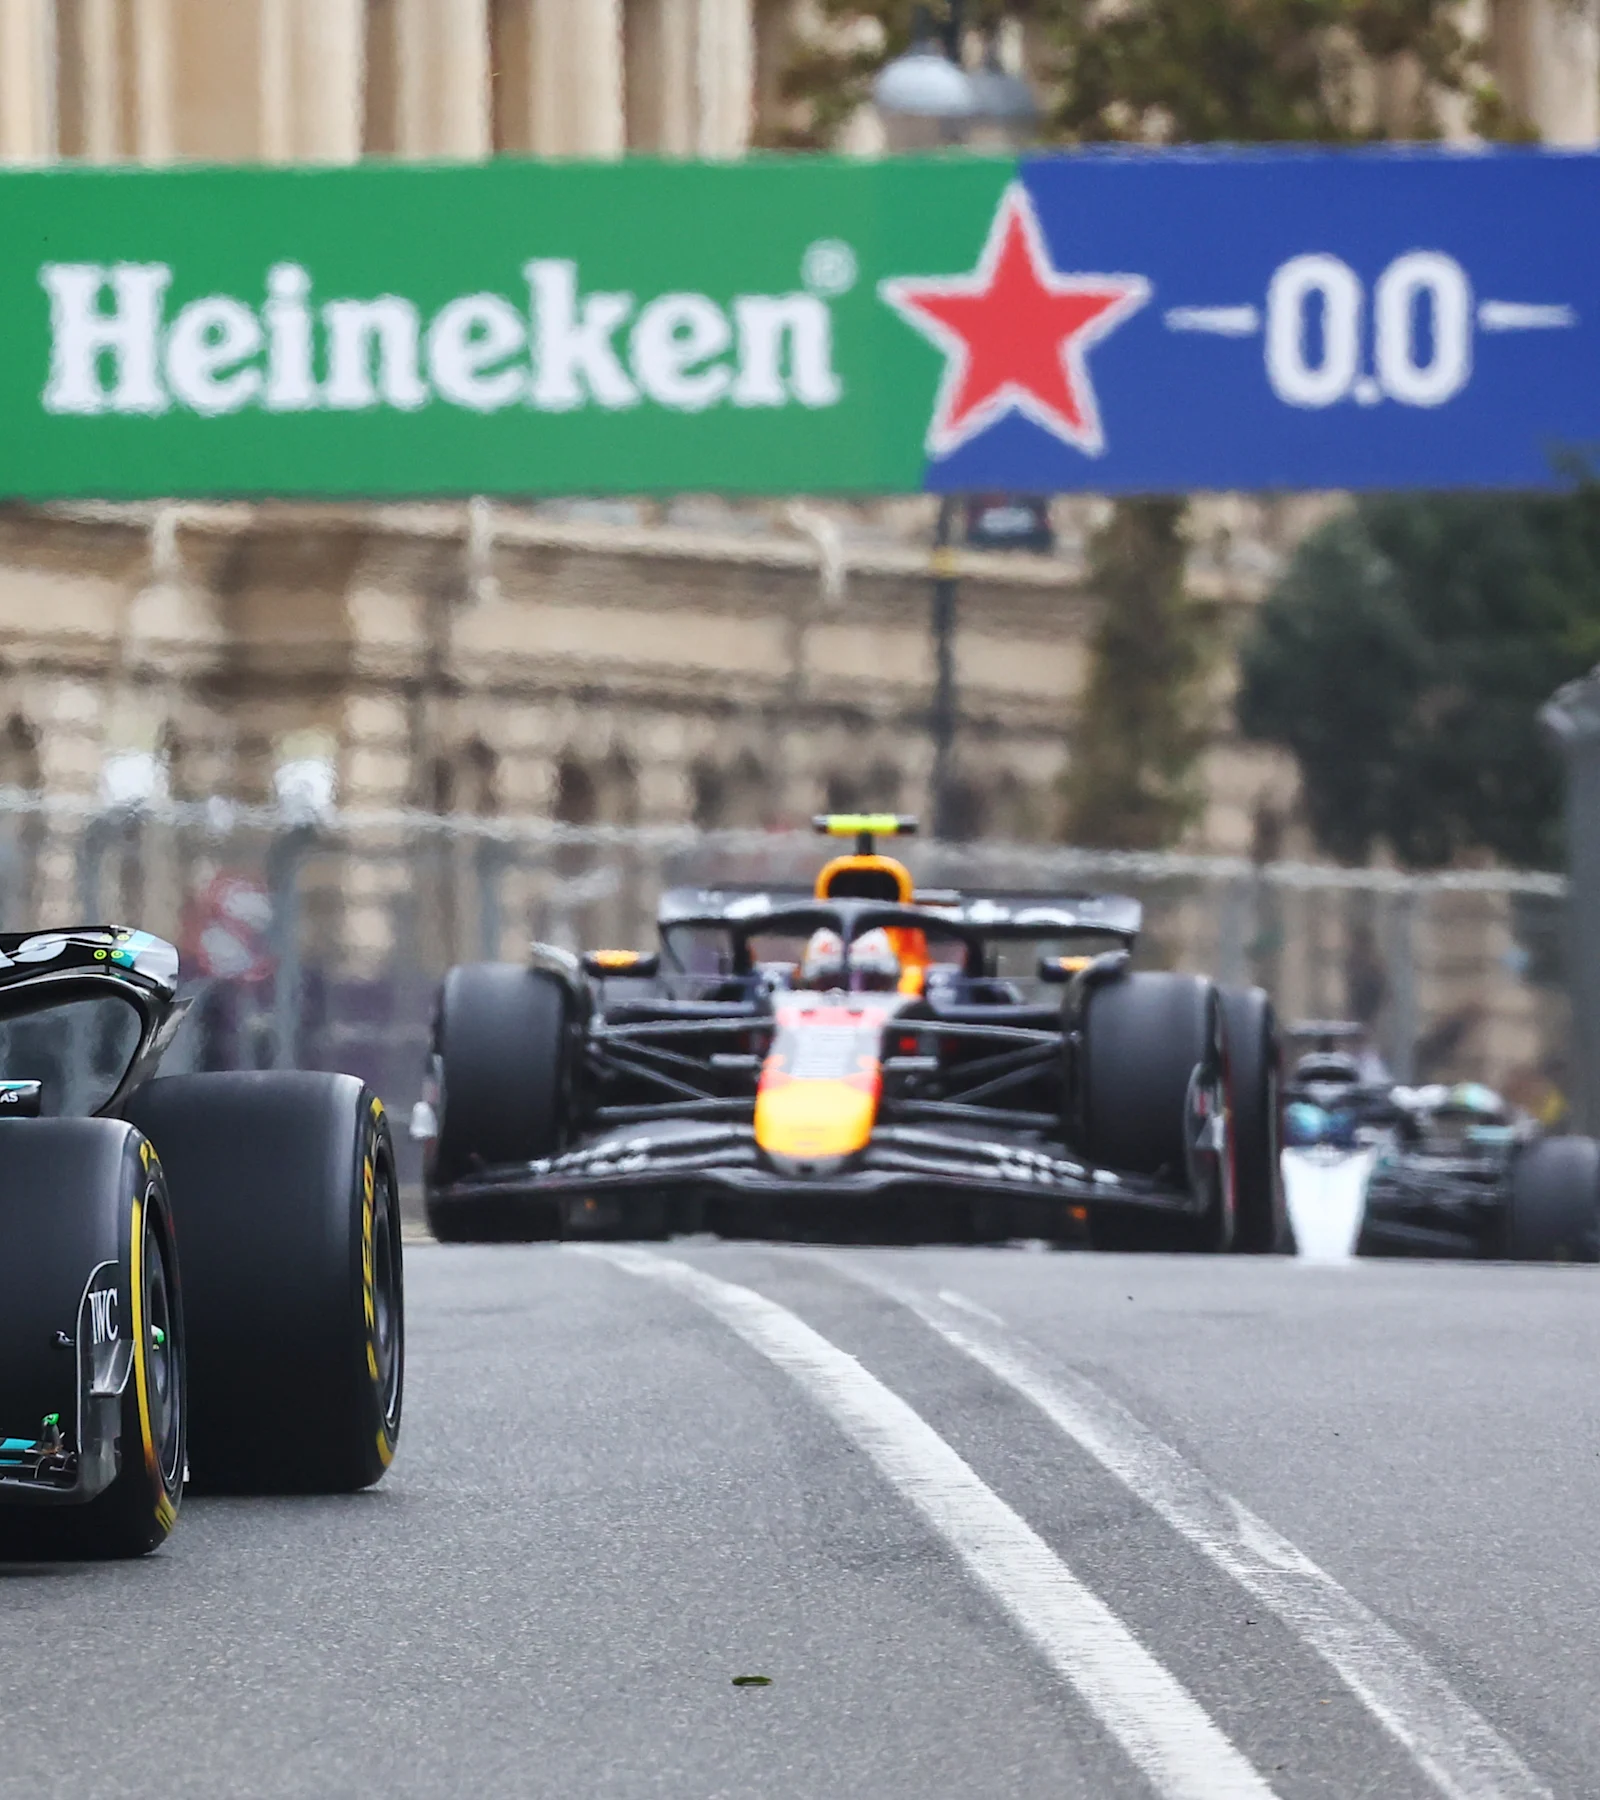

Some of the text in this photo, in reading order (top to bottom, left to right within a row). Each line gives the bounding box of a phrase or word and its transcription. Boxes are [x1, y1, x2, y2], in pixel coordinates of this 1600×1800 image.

[42, 260, 841, 413] Heineken
[1266, 250, 1473, 408] 0.0
[88, 1288, 119, 1345] IWC
